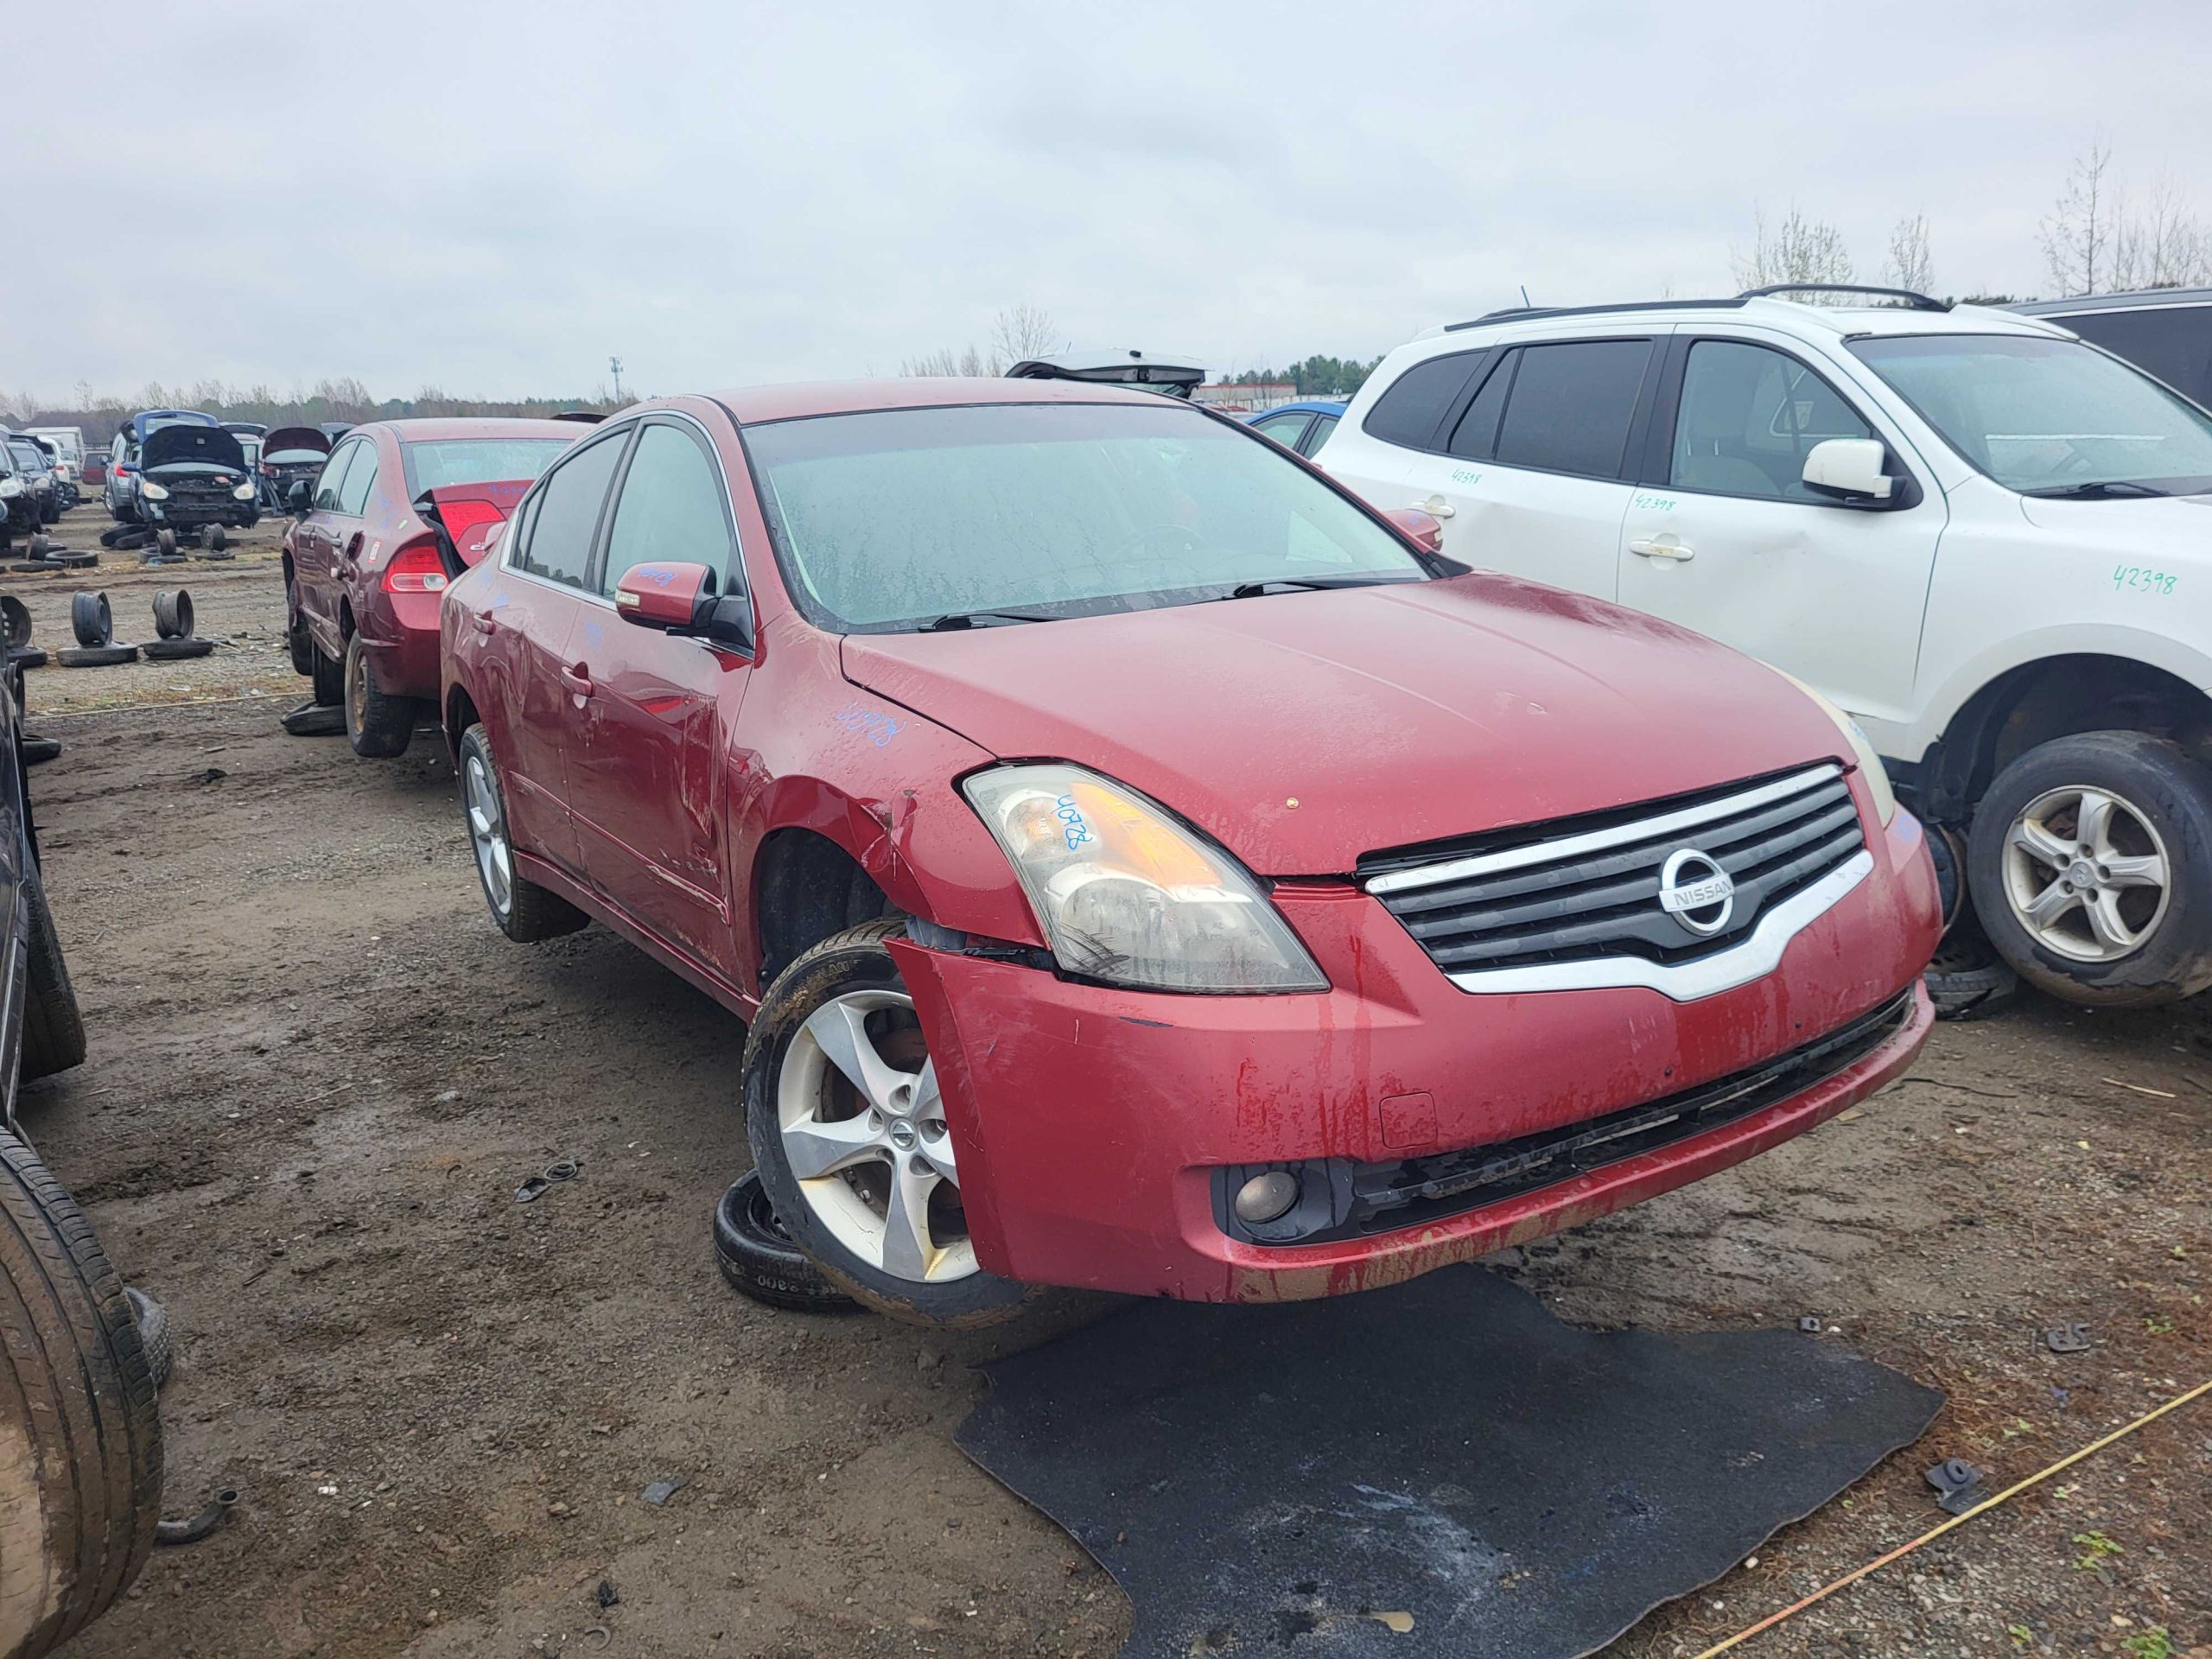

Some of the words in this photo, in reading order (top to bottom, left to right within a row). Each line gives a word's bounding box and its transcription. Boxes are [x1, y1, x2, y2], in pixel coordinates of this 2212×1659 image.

[1635, 493, 1676, 512] 42398
[2113, 564, 2177, 594] 42398
[1051, 794, 1093, 850] 40728
[1673, 881, 1732, 906] NISSAN
